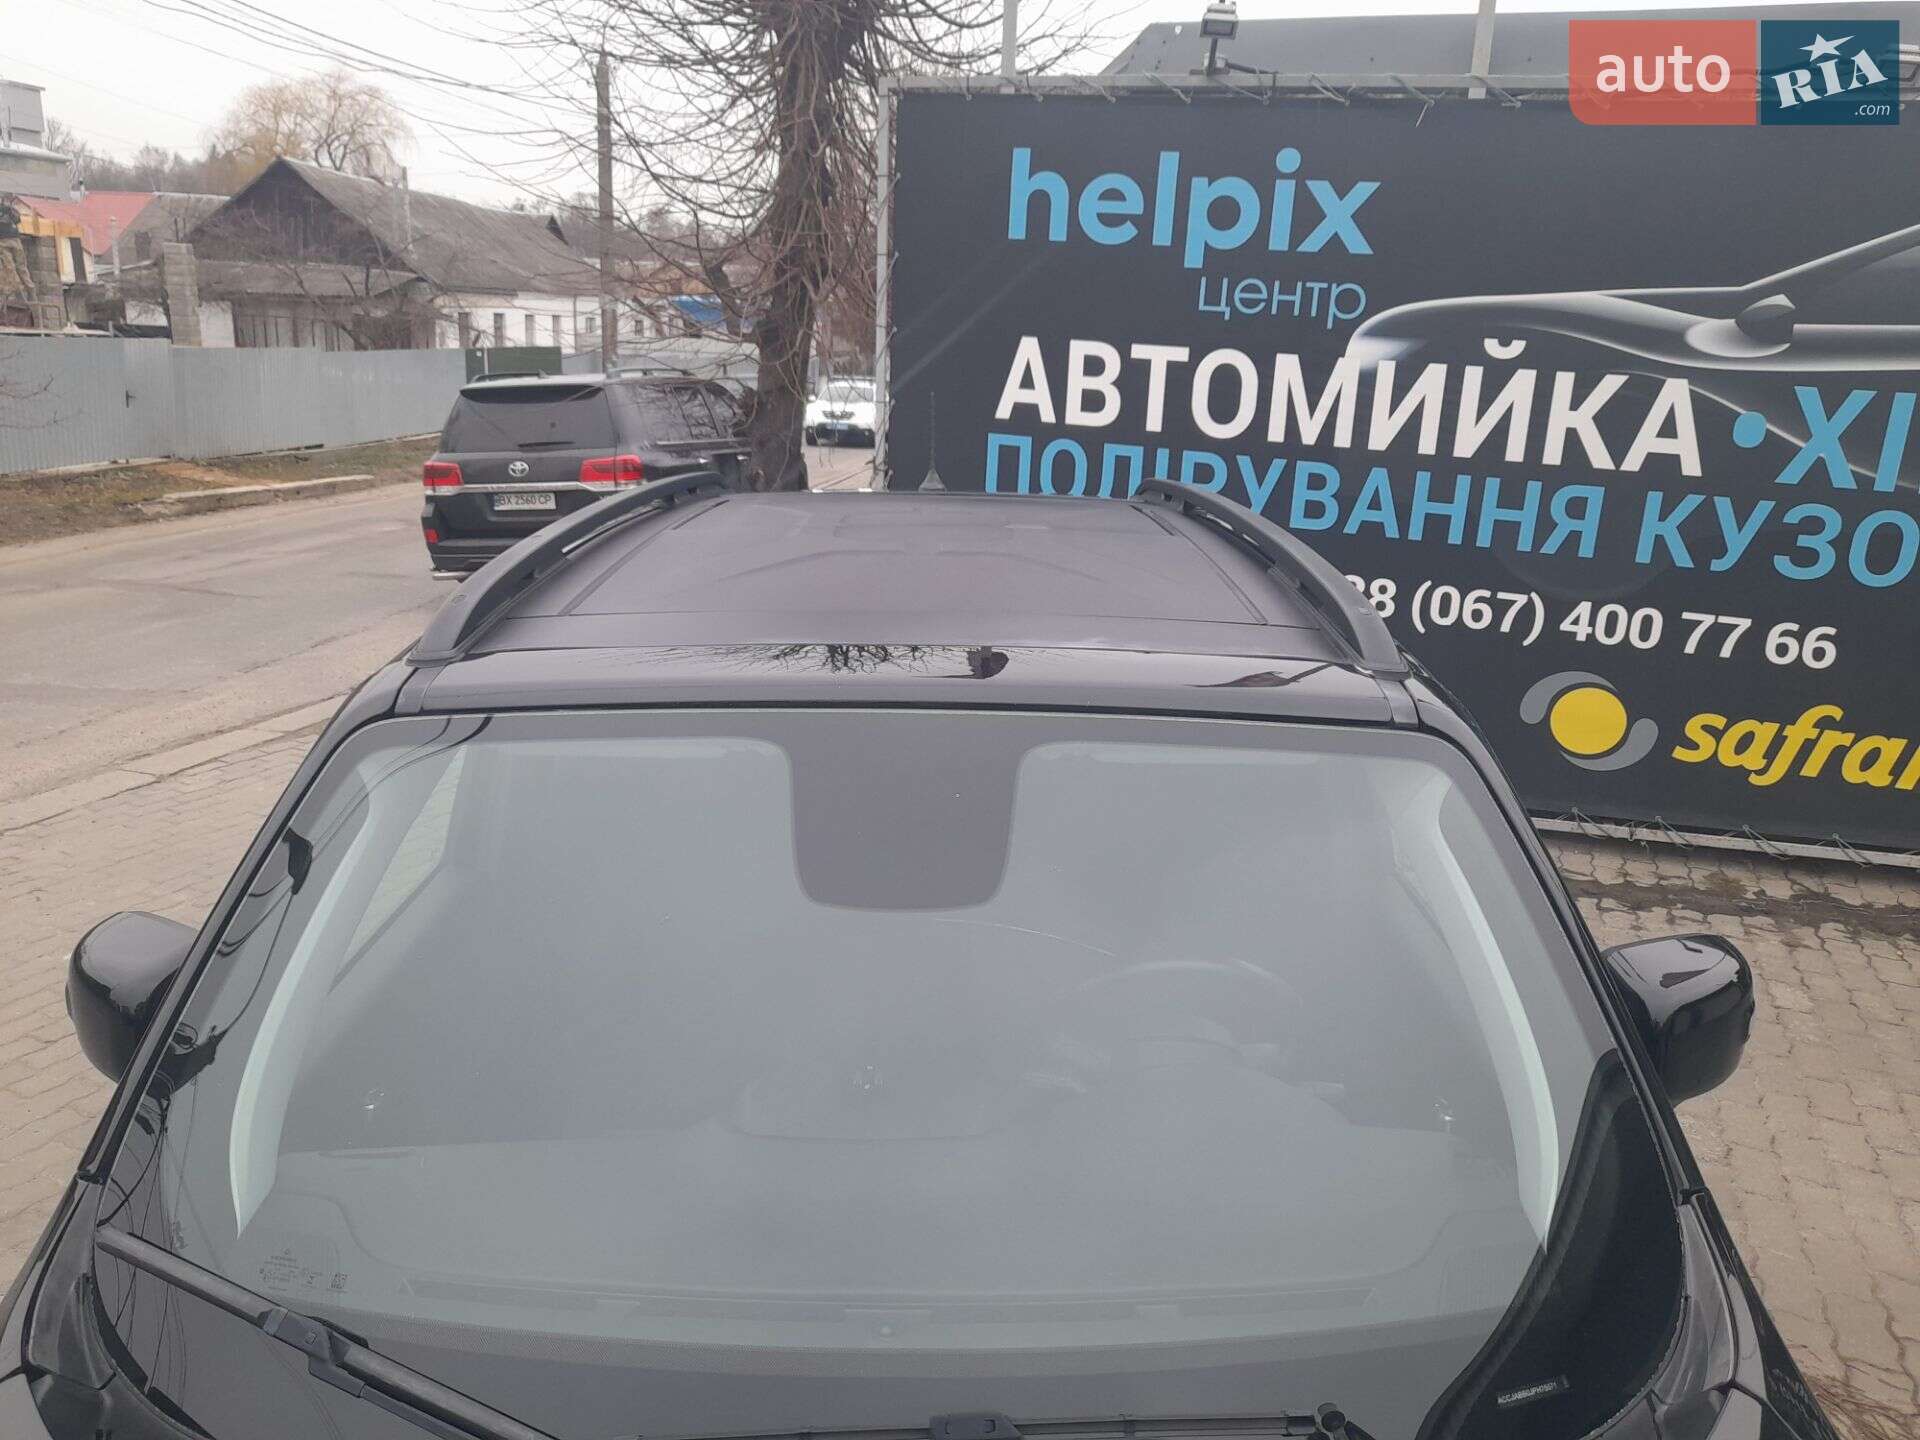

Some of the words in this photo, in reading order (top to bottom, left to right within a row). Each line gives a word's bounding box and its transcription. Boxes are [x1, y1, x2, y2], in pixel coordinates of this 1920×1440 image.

[1008, 147, 1381, 269] helpix
[1198, 276, 1366, 329] центр
[995, 335, 1703, 477] АВТОМИЙКА
[1774, 385, 1920, 494] ХІ
[514, 495, 536, 505] 2560
[984, 432, 1604, 560] ПОЛІРУВАННЯ
[1636, 491, 1920, 588] КУЗО
[1411, 580, 1545, 646] (067)
[1560, 602, 1662, 650] 400
[1681, 612, 1751, 657] 77
[1765, 622, 1837, 669] 66
